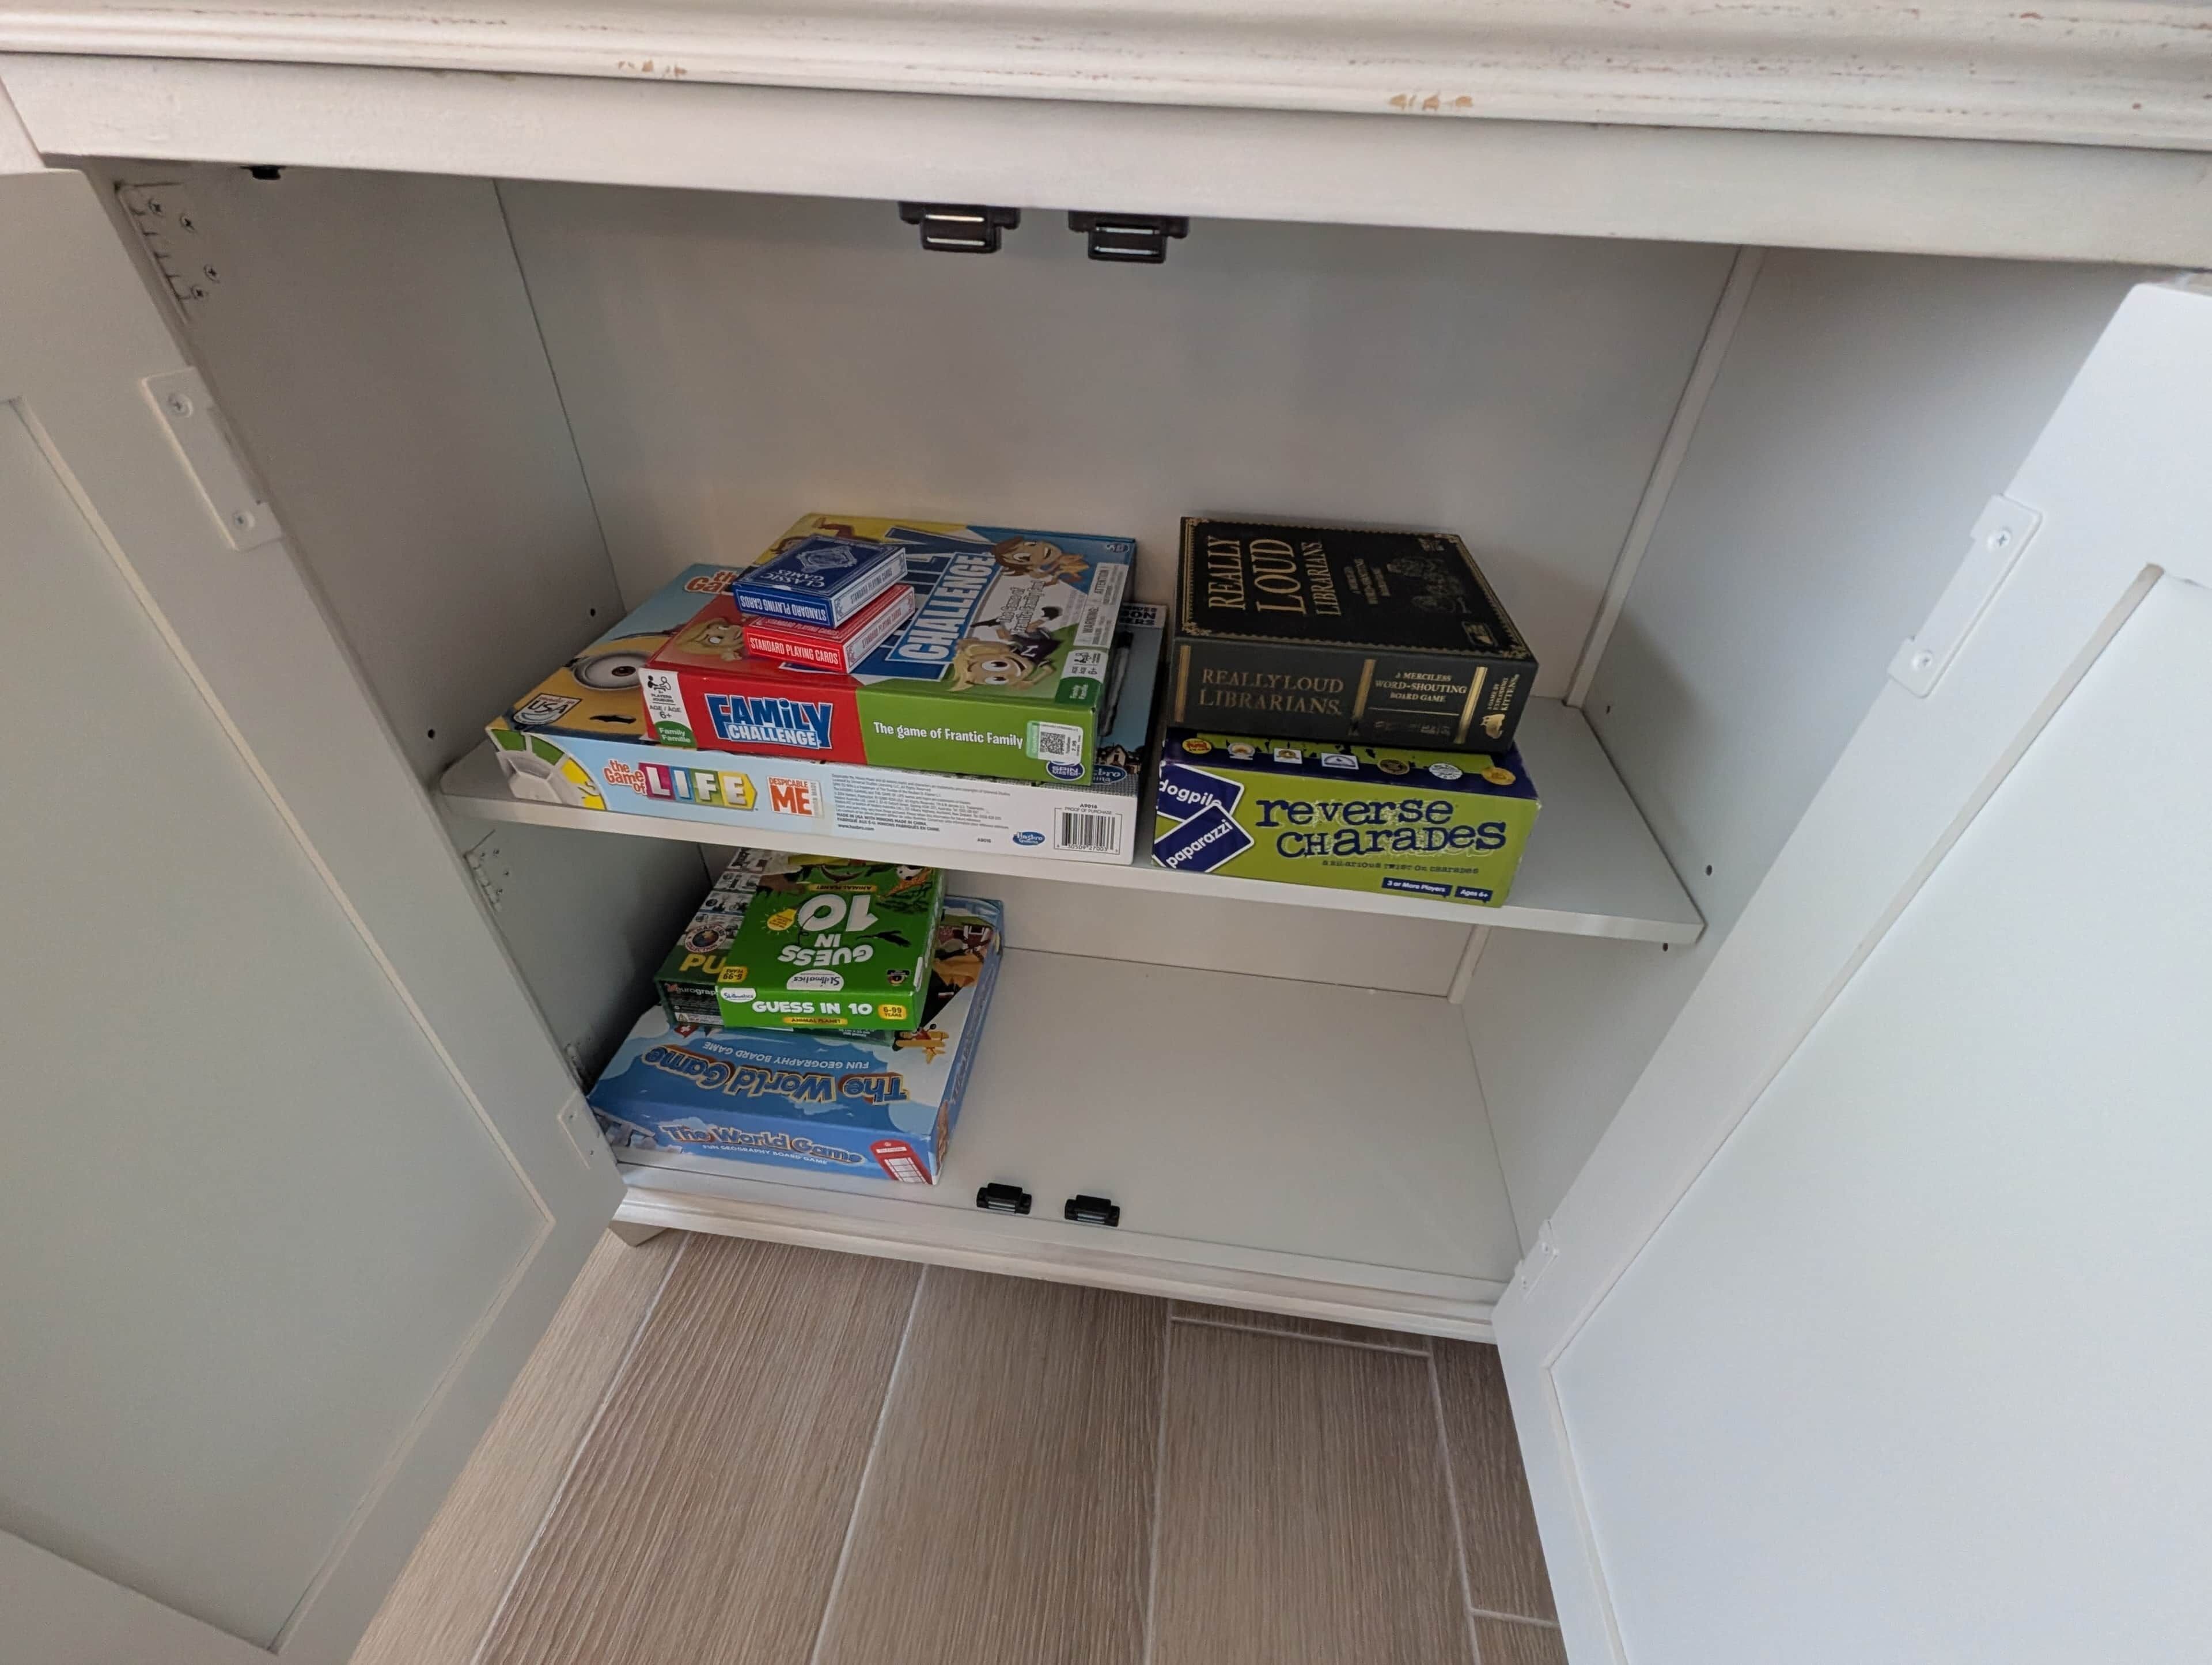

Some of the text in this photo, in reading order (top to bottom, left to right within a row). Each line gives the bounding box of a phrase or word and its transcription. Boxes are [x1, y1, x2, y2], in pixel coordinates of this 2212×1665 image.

[760, 572, 824, 587] CLASSIC
[778, 569, 824, 581] GAMES
[1207, 536, 1245, 610] REALLY
[1249, 538, 1306, 615] LOUD
[1301, 541, 1342, 616] LIBRARIANS
[740, 596, 827, 621] STANDARD PLAYING CARDS
[898, 554, 997, 660] CHALLENGE
[750, 638, 839, 665] STANDARD PLAYING CARDS
[1202, 668, 1344, 693] REALLY LOUD
[1375, 680, 1468, 694] WORD-SHOUTING
[1403, 672, 1452, 682] MERCILESS
[528, 700, 569, 714] USA
[1390, 692, 1446, 702] BOARD GAME
[659, 727, 685, 736] Family
[662, 735, 691, 743] Famille
[728, 725, 817, 746] CHALLENGE
[873, 722, 894, 734] The
[897, 725, 927, 739] game
[930, 728, 942, 739] of
[945, 728, 984, 743] Frantic
[987, 732, 1024, 749] Family
[604, 768, 645, 784] Game
[609, 760, 630, 773] the
[634, 766, 748, 805] of LIFE
[768, 777, 808, 788] DESPICABLE
[770, 785, 813, 815] ME
[1256, 799, 1454, 827] reverse
[1016, 831, 1044, 842] Hasbro
[1165, 818, 1233, 869] paparazzi
[1421, 884, 1446, 893] Players
[1460, 889, 1478, 897] Ages
[798, 894, 879, 932] 10
[814, 933, 842, 947] IN
[778, 943, 874, 967] GUESS
[793, 976, 840, 987] Skillmatics
[752, 1001, 873, 1015] GUESS IN 10
[703, 1042, 870, 1069] FUN GEOGRAPHY BOARD GAME
[643, 1046, 909, 1105] The World Game
[660, 1125, 865, 1164] The World Game
[719, 1145, 771, 1155] GEOGRAPHY
[772, 1151, 801, 1159] BOARD
[803, 1155, 828, 1165] GAME
